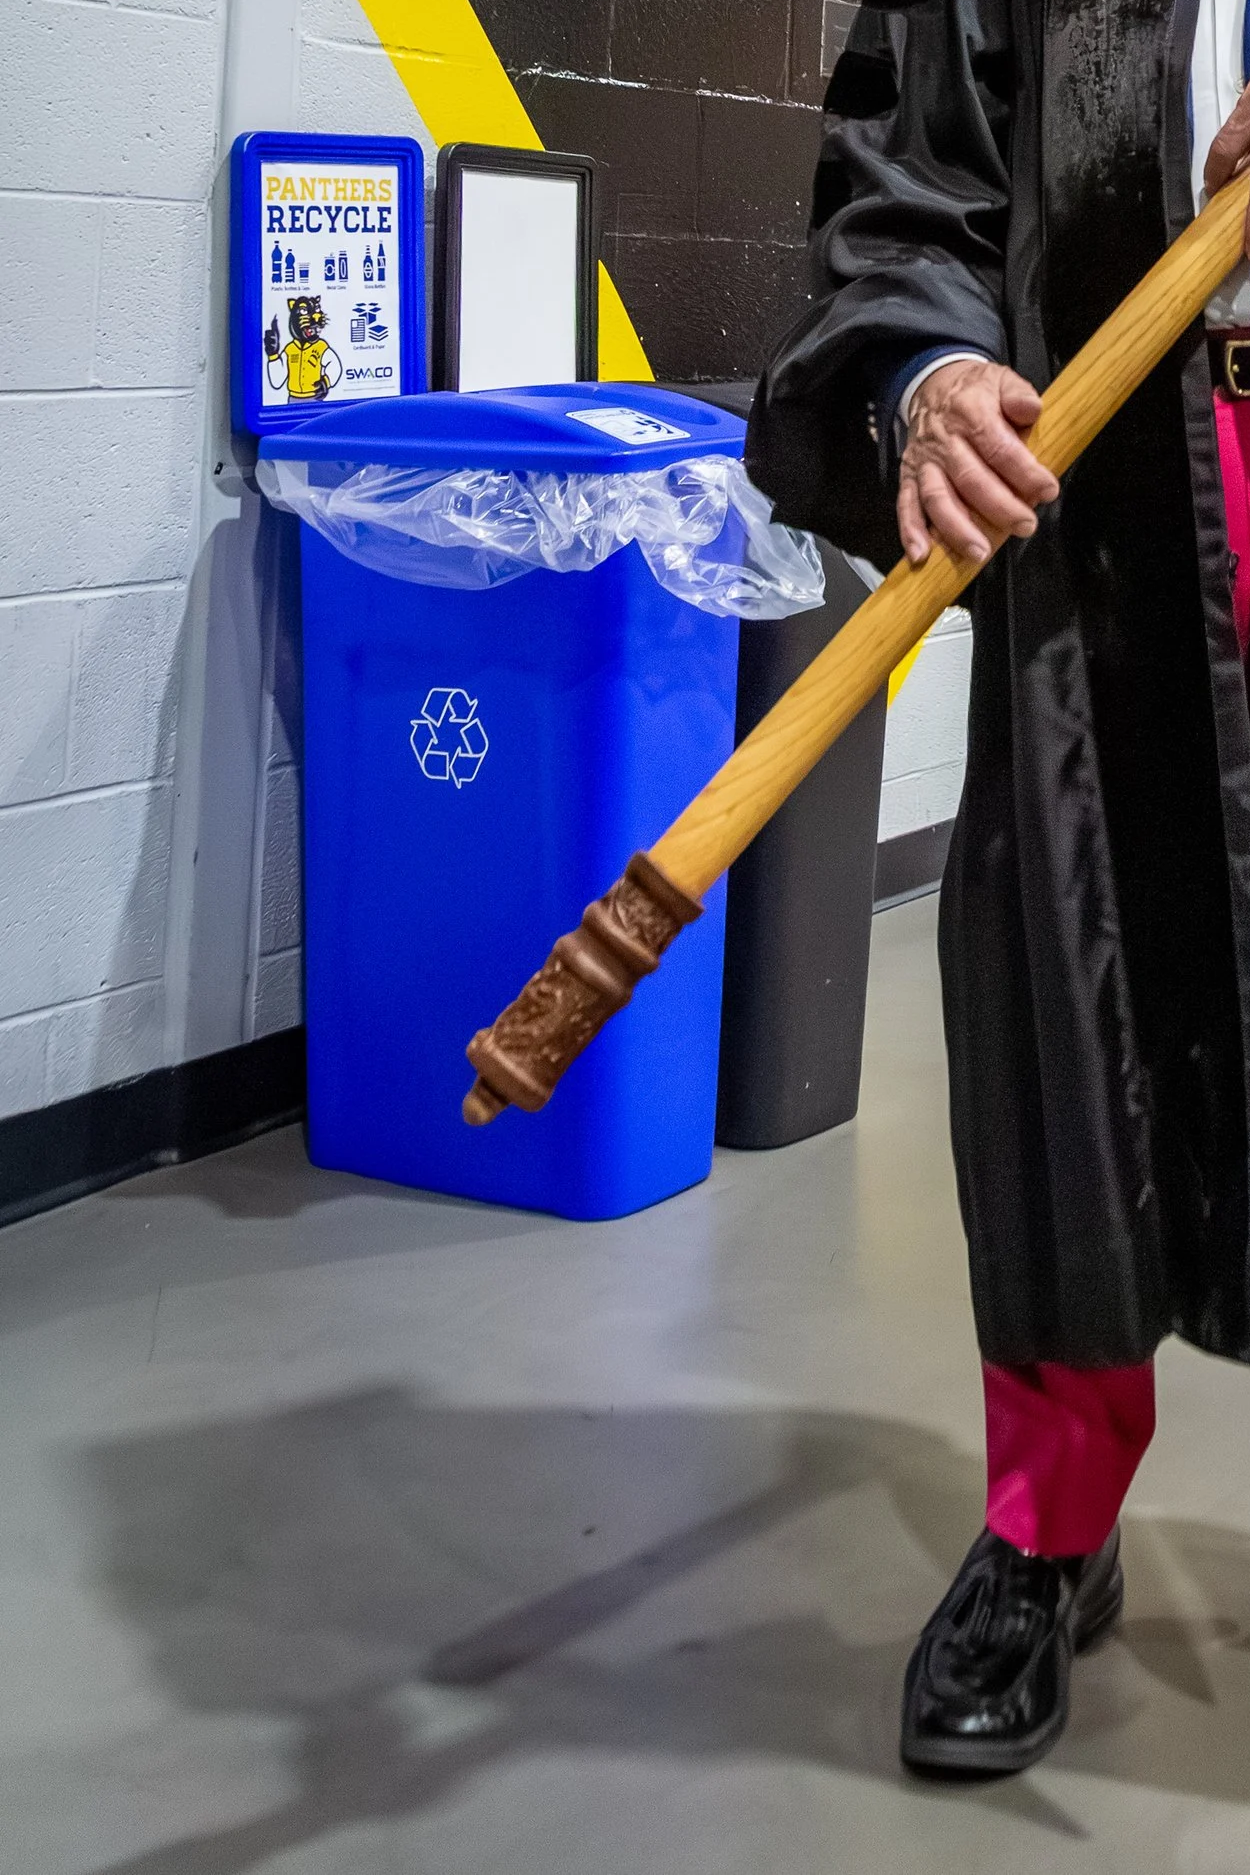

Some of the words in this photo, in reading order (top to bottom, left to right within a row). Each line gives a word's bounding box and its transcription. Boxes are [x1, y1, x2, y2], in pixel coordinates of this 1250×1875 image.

[266, 176, 392, 202] PANTHERS
[266, 205, 392, 233] RECYCLE
[345, 366, 393, 380] SWACO
